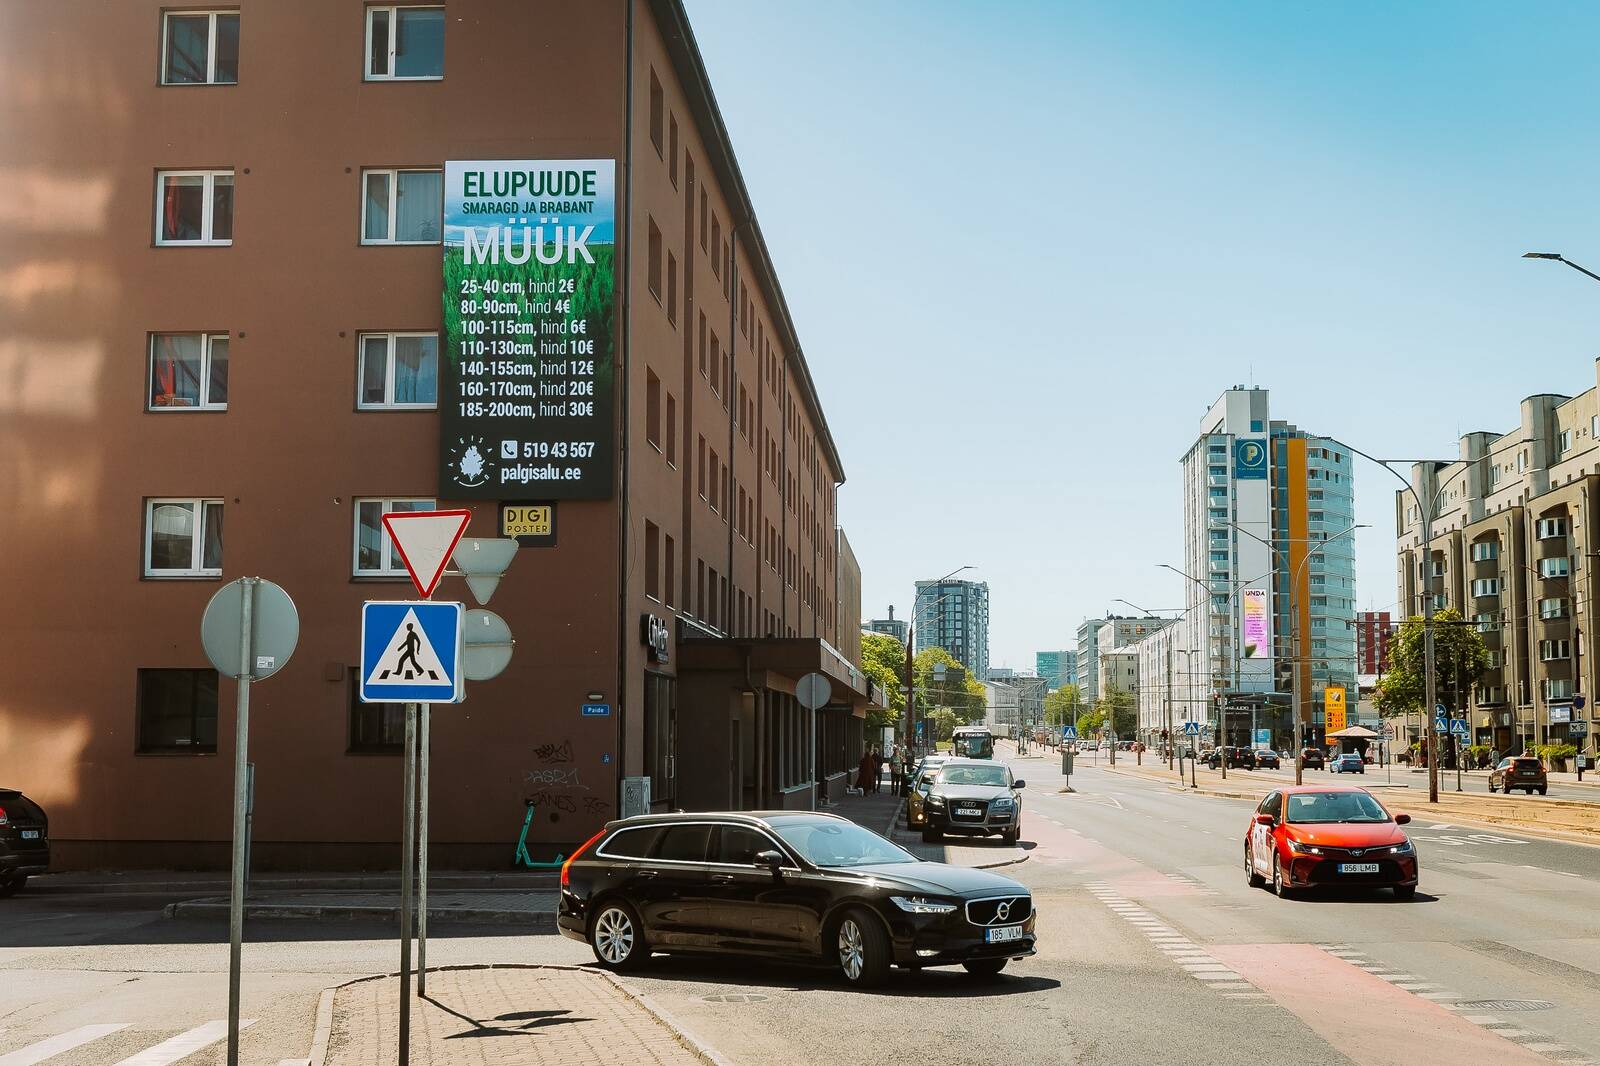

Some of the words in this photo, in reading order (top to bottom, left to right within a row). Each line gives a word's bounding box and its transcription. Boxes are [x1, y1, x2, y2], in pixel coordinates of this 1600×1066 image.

[463, 170, 596, 198] ELUPUUDE
[462, 202, 519, 214] SMARAGD
[522, 202, 537, 214] JA
[540, 201, 594, 214] BRABANT
[463, 217, 595, 265] MÜÜK
[461, 280, 499, 294] 25-40
[503, 283, 525, 296] cm,
[529, 279, 555, 293] hind
[558, 279, 574, 293] 2€
[461, 300, 521, 316] 80-90cm,
[525, 299, 551, 314] hind
[554, 299, 570, 313] 4€
[461, 320, 537, 336] 100-115cm,
[541, 319, 566, 334] hind
[570, 320, 586, 334] 6€
[460, 340, 536, 357] 110-130cm,
[540, 339, 567, 355] hind
[570, 340, 594, 354] 10€
[460, 361, 536, 378] 140-155cm,
[540, 360, 566, 375] hind
[570, 361, 594, 375] 12€
[459, 382, 536, 398] 160-170cm,
[540, 381, 566, 396] hind
[569, 381, 593, 396] 20€
[459, 402, 536, 419] 185-200cm,
[540, 401, 566, 416] hind
[569, 402, 593, 417] 30€
[523, 442, 550, 458] 519
[551, 442, 569, 458] 43
[570, 442, 595, 458] 567
[501, 463, 581, 483] palgisalu.ee
[507, 509, 548, 523] DIGI
[991, 930, 1002, 940] 185
[1008, 928, 1021, 939] VLM
